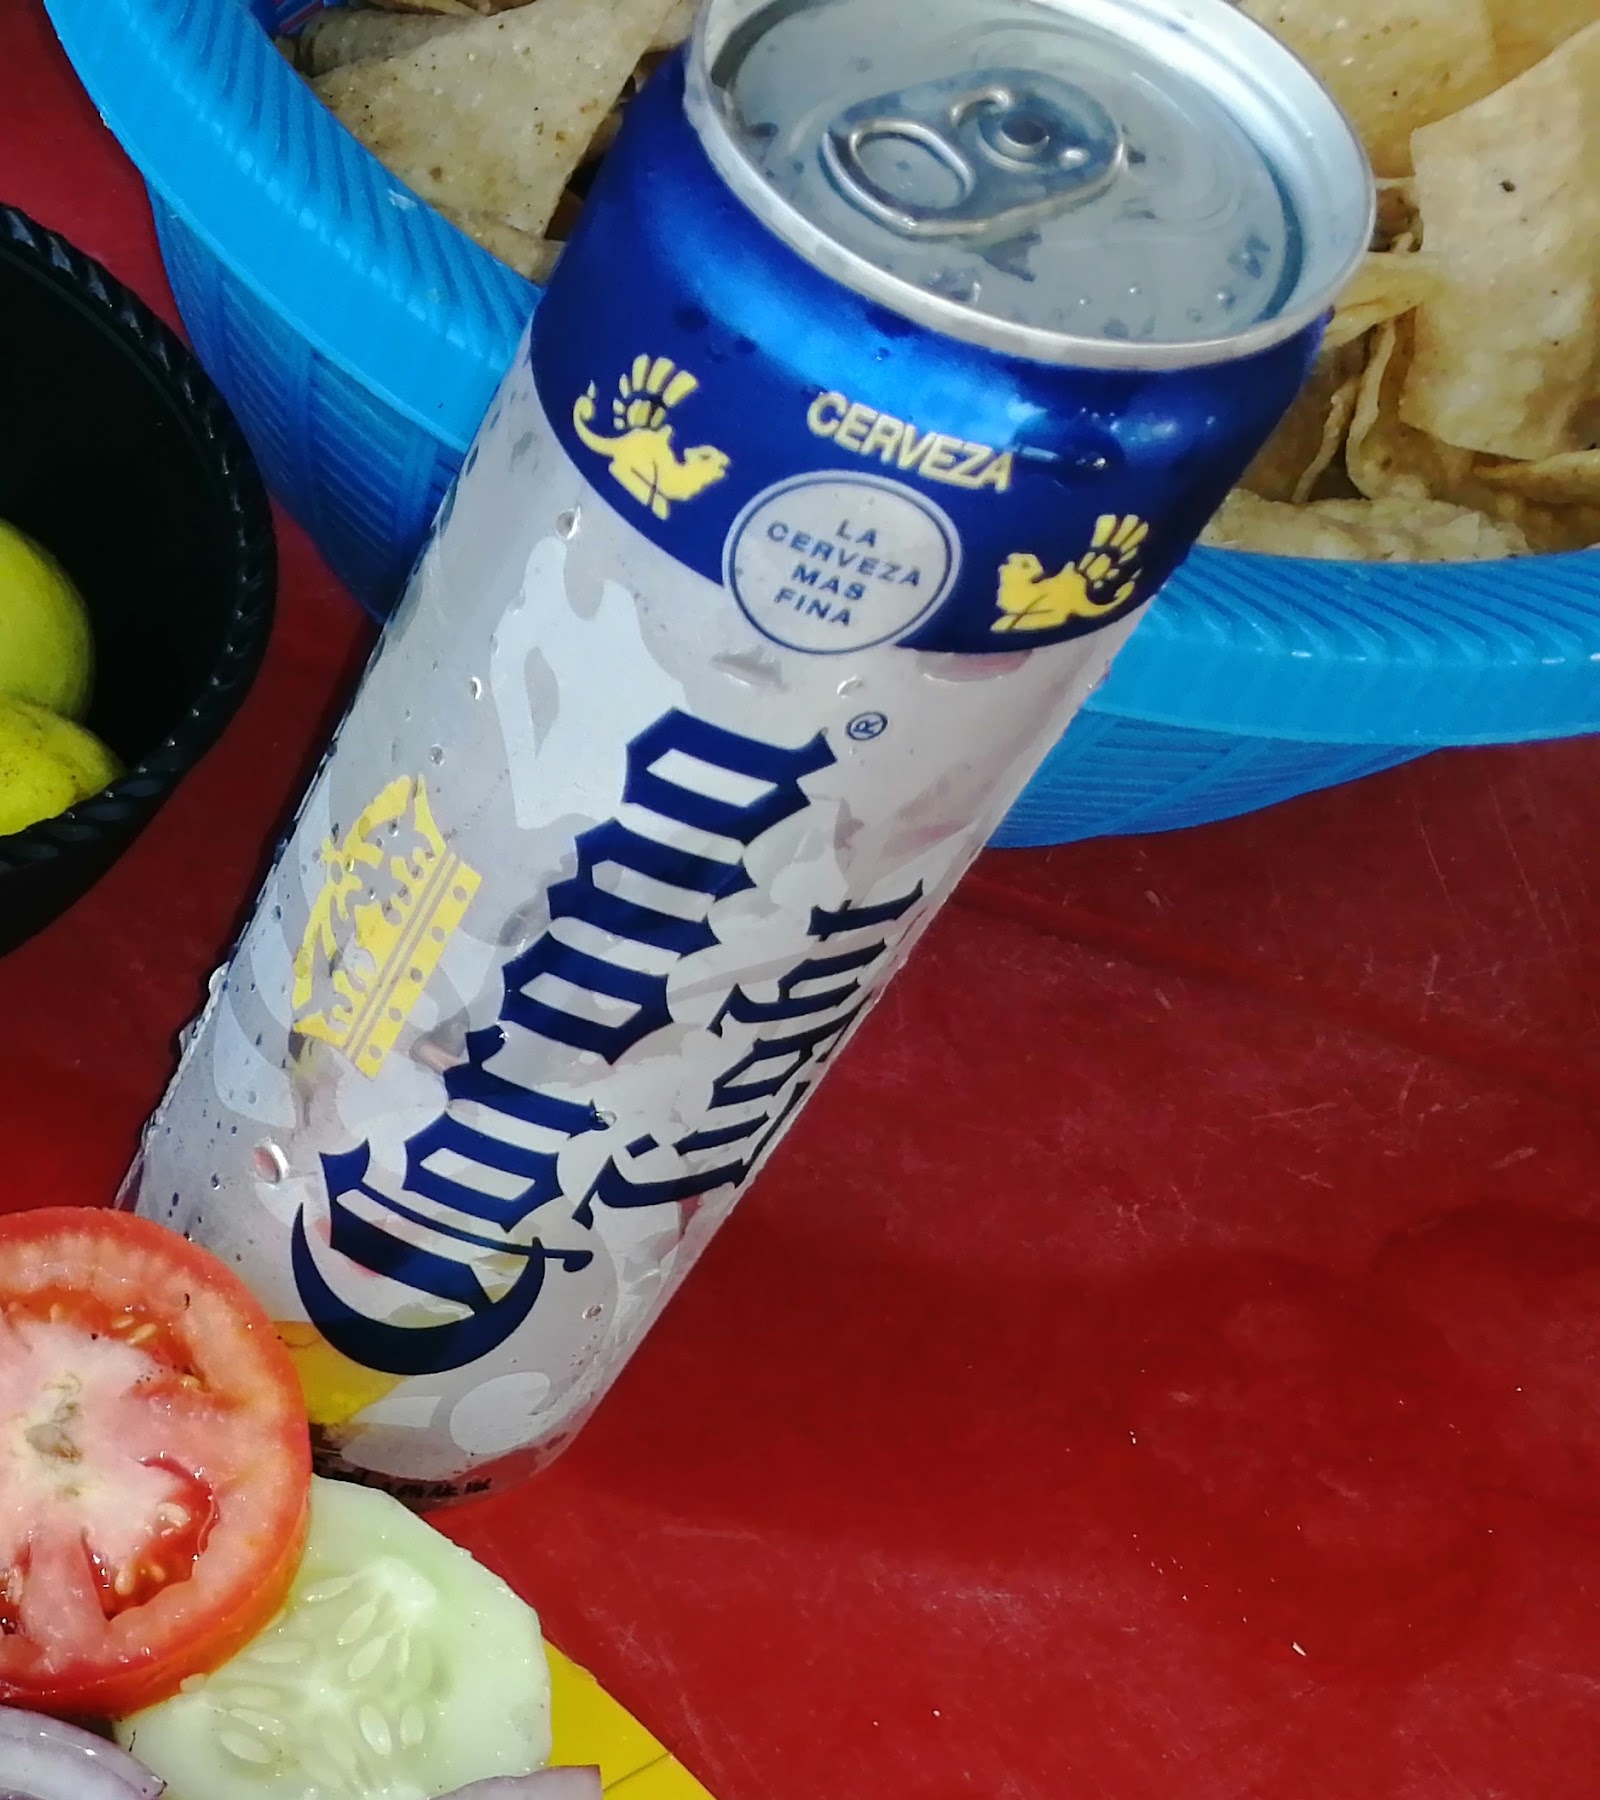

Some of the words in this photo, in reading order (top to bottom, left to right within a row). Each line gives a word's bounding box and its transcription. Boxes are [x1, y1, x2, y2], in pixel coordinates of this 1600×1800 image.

[806, 391, 1015, 494] CERVEZA
[767, 521, 924, 588] CERVEZA
[835, 519, 879, 549] LA
[773, 586, 853, 627] FINA
[790, 563, 868, 602] MAS
[290, 705, 838, 1377] Corona
